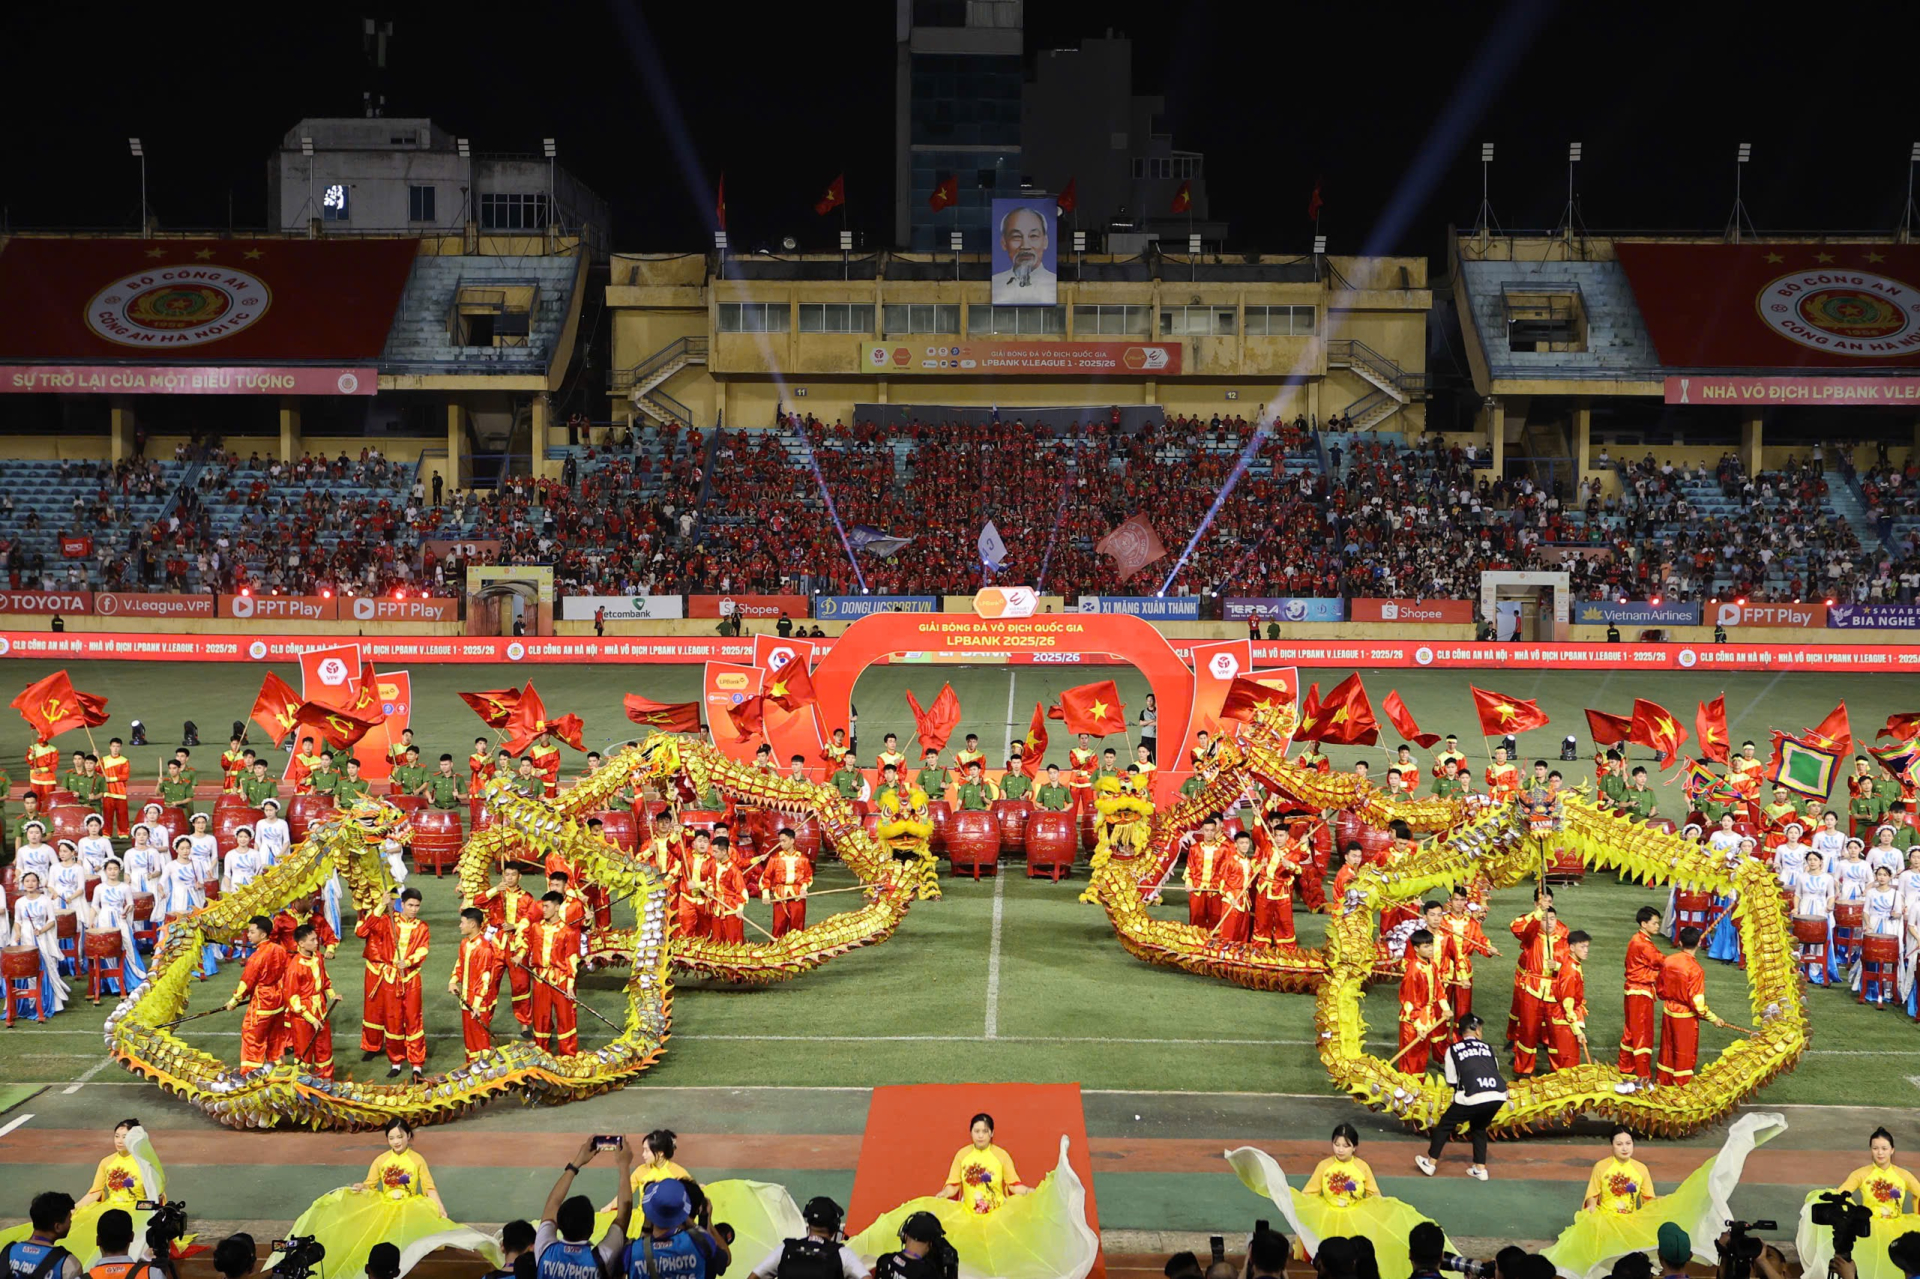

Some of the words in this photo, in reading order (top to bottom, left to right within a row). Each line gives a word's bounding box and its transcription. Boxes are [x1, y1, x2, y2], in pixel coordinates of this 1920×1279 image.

[126, 275, 155, 291] BỘ
[162, 269, 222, 281] CÔNG
[223, 276, 249, 291] AN
[1777, 282, 1802, 297] BỘ
[1803, 274, 1864, 286] CÔNG
[1871, 282, 1902, 296] AN
[98, 310, 128, 336] CÔNG
[129, 332, 155, 342] AN
[160, 332, 190, 343] HÀ
[194, 322, 230, 340] NỘI
[230, 311, 251, 327] FC
[1780, 320, 1830, 345] CÔNG
[1834, 340, 1864, 350] AN
[1869, 341, 1900, 351] HÀ
[1078, 360, 1116, 368] 2025/26
[13, 373, 36, 390] SỰ
[40, 371, 75, 387] TRỞ
[78, 374, 106, 391] LẠI
[110, 368, 146, 388] CỦA
[150, 372, 188, 392] MỘT
[192, 369, 230, 388] BIỂU
[234, 373, 295, 392] TƯỢNG
[1702, 382, 1738, 399] NHÀ
[1742, 383, 1766, 399] VÔ
[1768, 386, 1809, 402] ĐỊCH
[1812, 386, 1880, 398] LPBANK
[453, 544, 476, 556] 10
[11, 595, 84, 610] TOYOTA
[123, 600, 211, 614] V.League.VPF
[256, 600, 287, 616] FPT
[290, 601, 323, 619] Play
[1102, 602, 1112, 614] XI
[1113, 599, 1140, 614] MĂNG
[1142, 600, 1166, 614] XUÂN
[1168, 600, 1196, 615] THÀNH
[1226, 604, 1279, 614] TERRA
[378, 602, 408, 617] FPT
[410, 603, 444, 620] Play
[594, 610, 651, 618] etcombank
[738, 603, 780, 617] Shopee
[1400, 606, 1442, 621] Shopee
[1604, 610, 1650, 620] Vietnam
[1651, 610, 1692, 621] Airlines
[1743, 608, 1774, 622] FPT
[1778, 608, 1812, 626] Play
[918, 620, 940, 632] GIẢI
[942, 622, 970, 632] BÓNG
[973, 622, 988, 632] ĐÁ
[990, 622, 1006, 632] VÔ
[1007, 624, 1030, 634] ĐỊCH
[1034, 621, 1064, 633] QUỐC
[1066, 624, 1084, 632] GIA
[1852, 616, 1875, 626] BIA
[1878, 616, 1916, 626] NGHE
[12, 640, 26, 650] CLB
[48, 641, 58, 650] AN
[59, 638, 70, 651] HÀ
[134, 642, 160, 652] LPBANK
[162, 642, 194, 653] V.LEAGUE
[206, 643, 238, 654] 2025/26
[946, 636, 1000, 646] LPBANK
[1003, 636, 1056, 646] 2025/26
[270, 644, 284, 654] CLB
[392, 645, 418, 655] LPBANK
[420, 645, 451, 655] V.LEAGUE
[463, 646, 495, 655] 2025/26
[528, 645, 542, 655] CLB
[563, 646, 573, 655] AN
[574, 643, 584, 656] HÀ
[650, 646, 676, 656] LPBANK
[677, 646, 710, 656] V.LEAGUE
[722, 646, 753, 656] 2025/26
[1298, 649, 1325, 658] LPBANK
[1326, 649, 1358, 659] V.LEAGUE
[1371, 650, 1403, 659] 2025/26
[1436, 650, 1450, 660] CLB
[1472, 650, 1482, 660] AN
[1484, 648, 1494, 660] HÀ
[1560, 651, 1588, 661] LPBANK
[1589, 651, 1622, 661] V.LEAGUE
[1634, 651, 1666, 662] 2025/26
[1032, 652, 1080, 662] 2025/26
[1700, 652, 1714, 662] CLB
[1736, 652, 1746, 662] AN
[1748, 650, 1758, 662] HÀ
[1824, 654, 1852, 663] LPBANK
[1853, 654, 1886, 664] V.LEAGUE
[1476, 1076, 1496, 1088] 140
